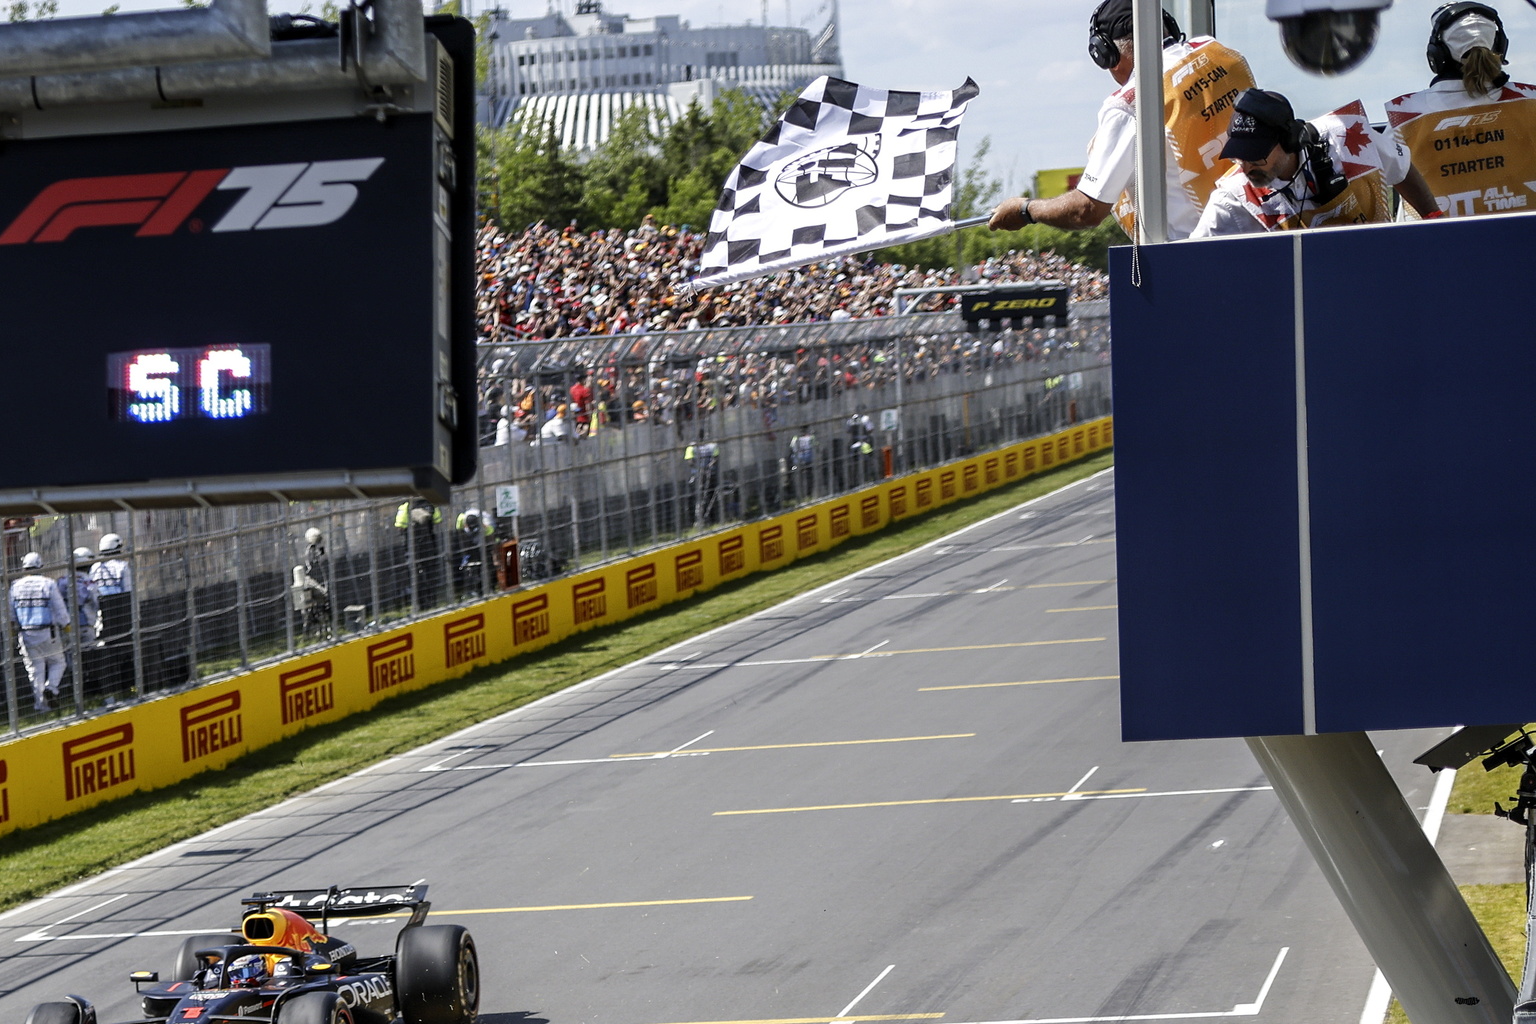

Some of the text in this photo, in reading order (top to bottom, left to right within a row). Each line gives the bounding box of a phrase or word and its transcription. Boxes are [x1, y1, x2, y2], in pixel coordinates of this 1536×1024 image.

[1434, 129, 1505, 152] 0114-CAN
[1440, 155, 1505, 177] STARTER
[1483, 185, 1514, 201] ALL
[971, 297, 1057, 312] P ZERO
[444, 613, 487, 669] PIRELLI
[511, 593, 550, 647] PIRELLI
[367, 632, 415, 694] PIRELLI
[279, 659, 334, 726] PIRELLI
[180, 689, 243, 763] PIRELLI
[62, 722, 136, 801] PIRELLI
